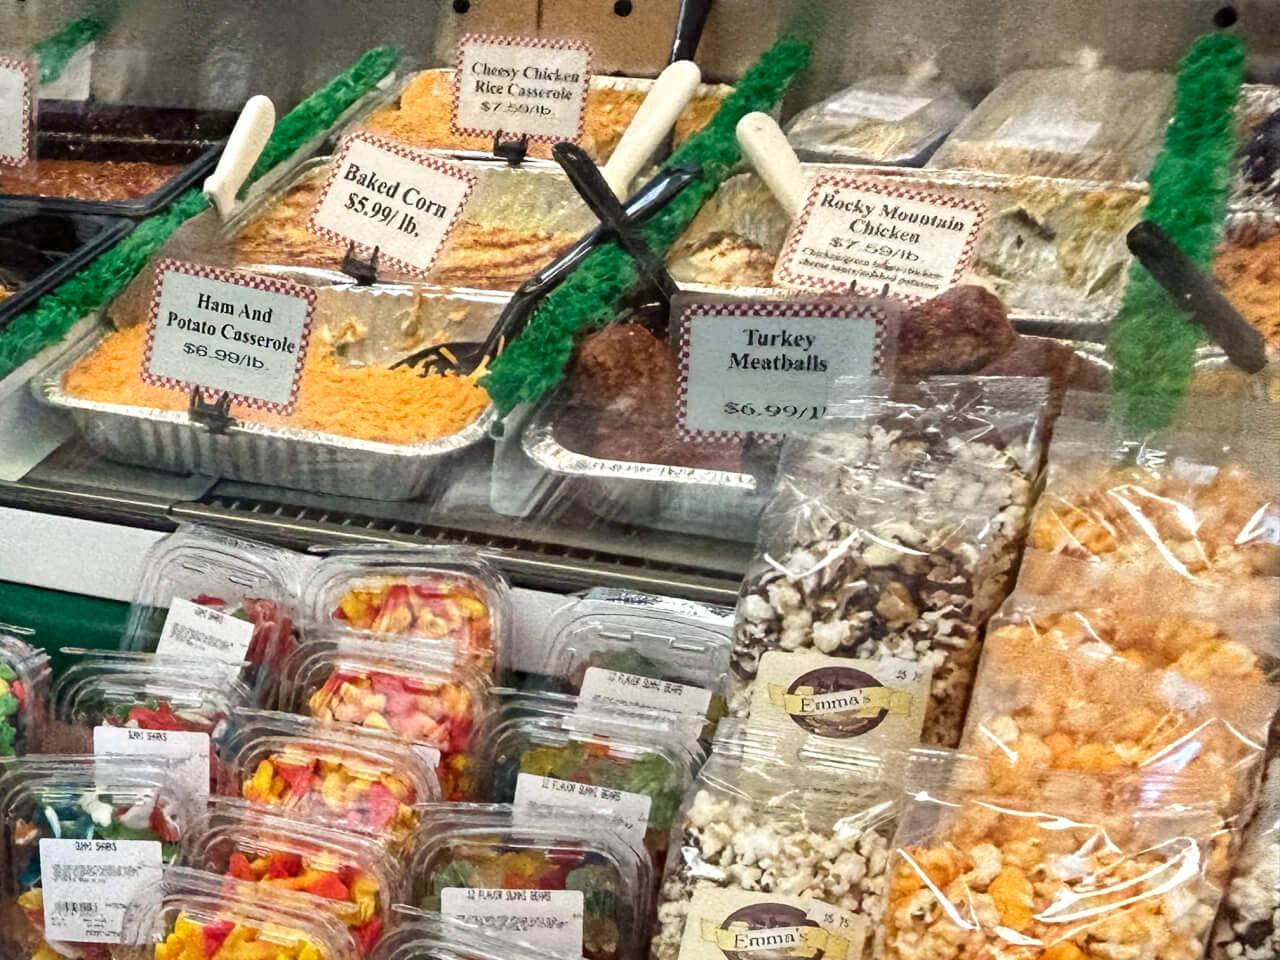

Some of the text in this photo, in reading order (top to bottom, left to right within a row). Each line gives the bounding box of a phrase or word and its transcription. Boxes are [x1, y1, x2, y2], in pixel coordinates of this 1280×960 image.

[471, 61, 580, 83] Cheesy Chicken
[475, 79, 573, 101] Rice Casserole
[343, 162, 447, 219] Baked Corn
[820, 191, 966, 232] Rocky Mountain
[848, 218, 921, 245] Chicken
[197, 292, 273, 324] Ham And
[166, 311, 296, 355] Potato Casserole
[742, 328, 817, 351] Turkey
[728, 352, 828, 373] Meatballs
[799, 689, 872, 713] Emma's
[734, 927, 808, 950] Emma's
